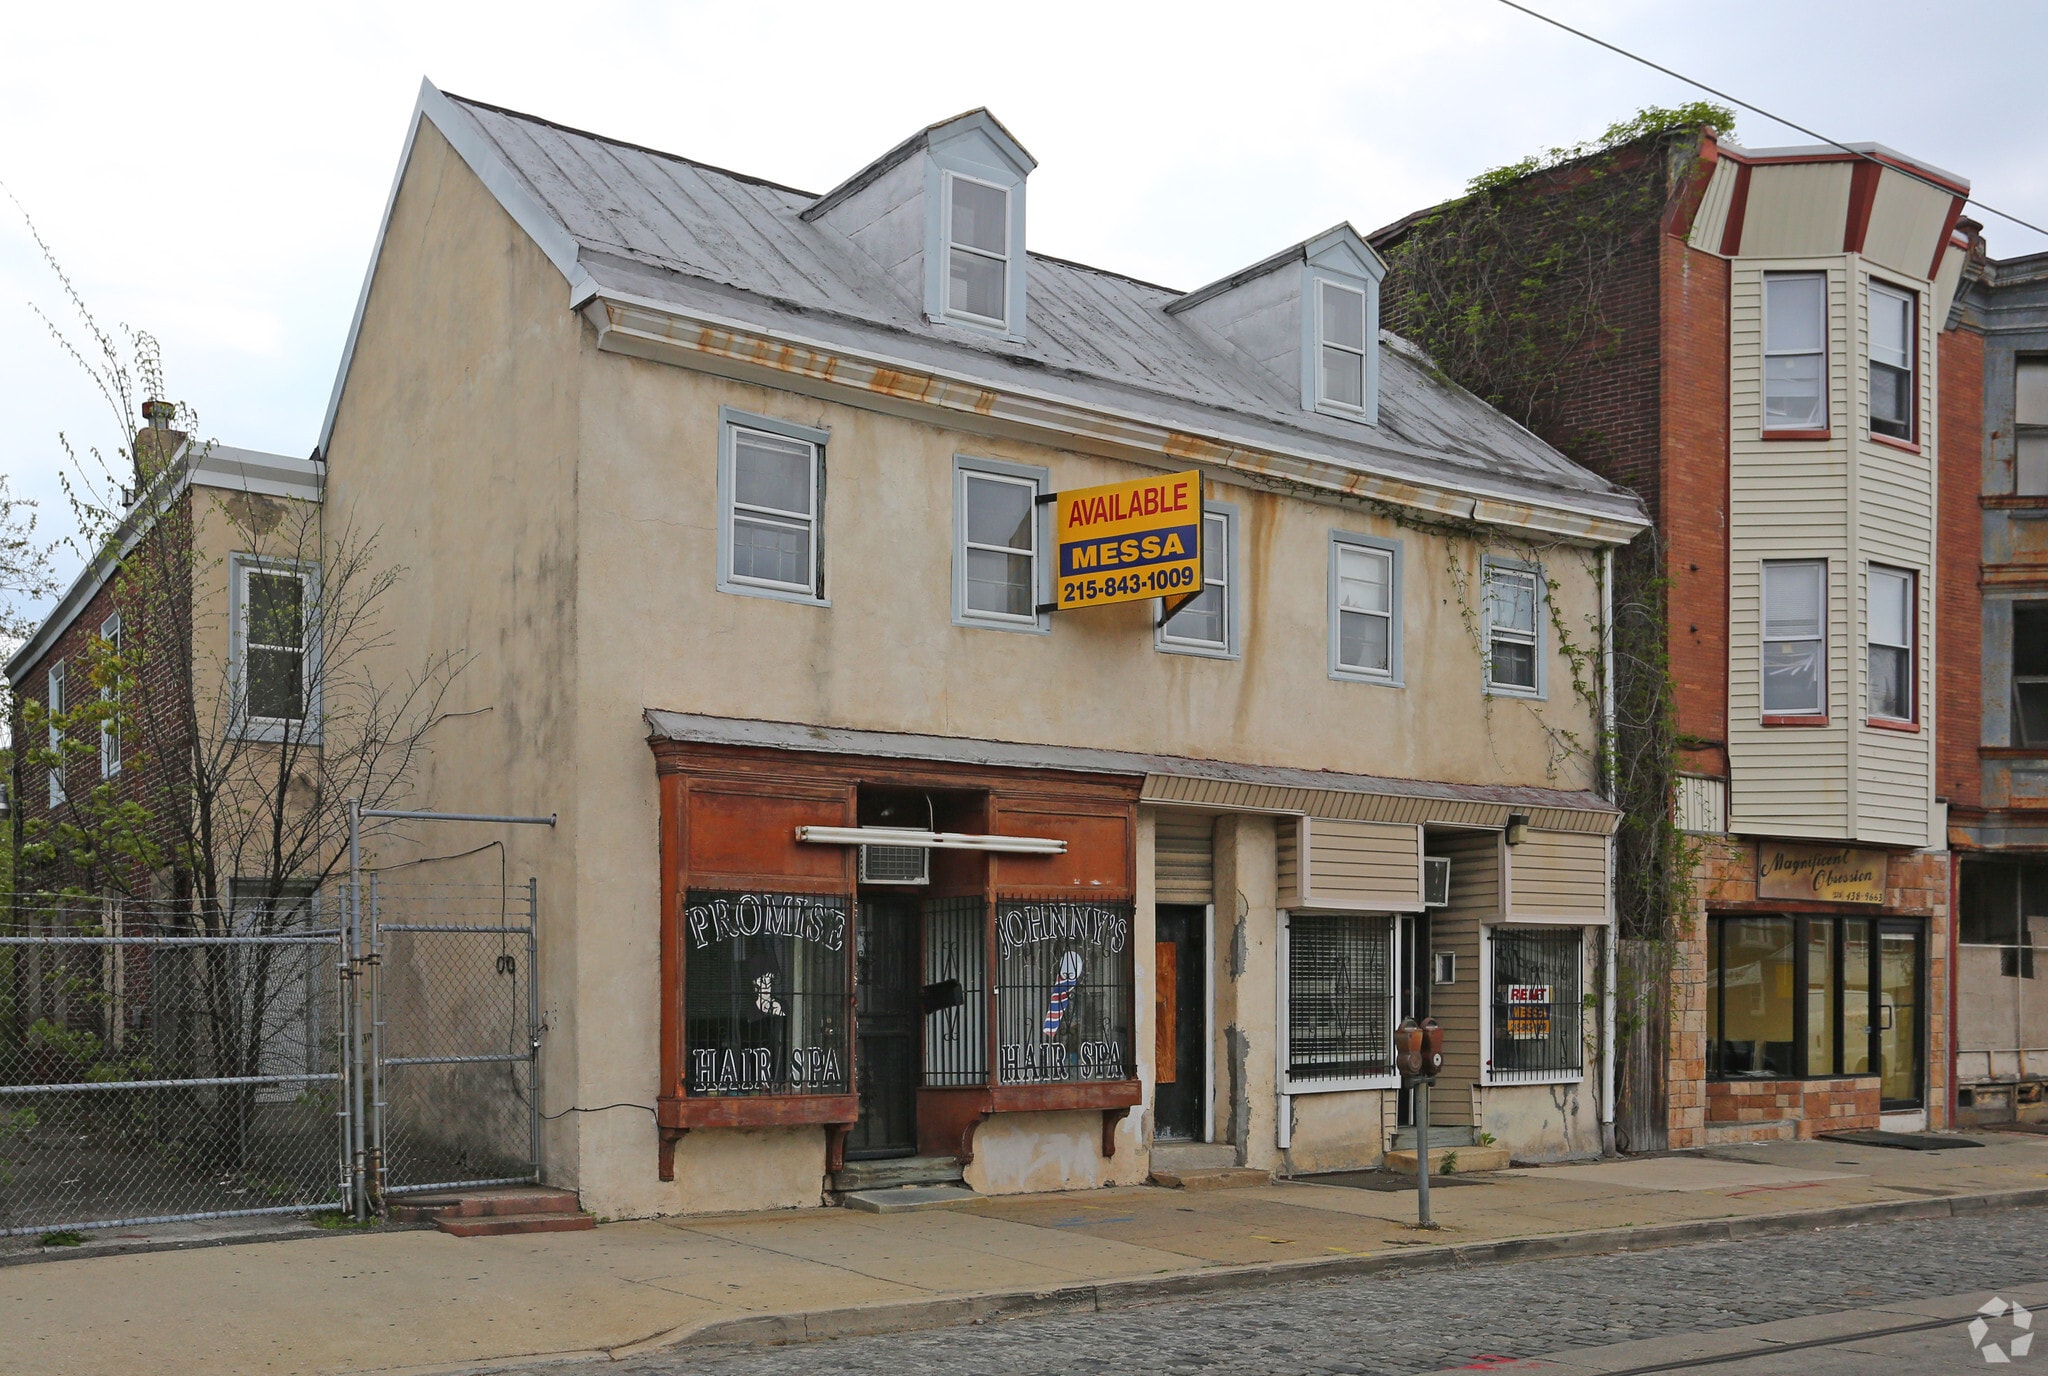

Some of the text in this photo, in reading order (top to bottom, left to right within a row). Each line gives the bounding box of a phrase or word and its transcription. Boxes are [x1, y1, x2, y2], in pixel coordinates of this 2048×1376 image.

[1068, 482, 1188, 528] AVAILABLE
[1072, 532, 1185, 570] MESSA
[1064, 566, 1194, 602] 215-843-1009
[1760, 849, 1850, 877] Magnificent
[1812, 869, 1873, 891] Obsession
[686, 894, 846, 951] PROMISE
[995, 903, 1127, 961] JOHNNY'S
[1510, 988, 1547, 1001] RENT
[693, 1046, 842, 1092] HAIR SPA
[1001, 1041, 1125, 1083] HAIR SPA
